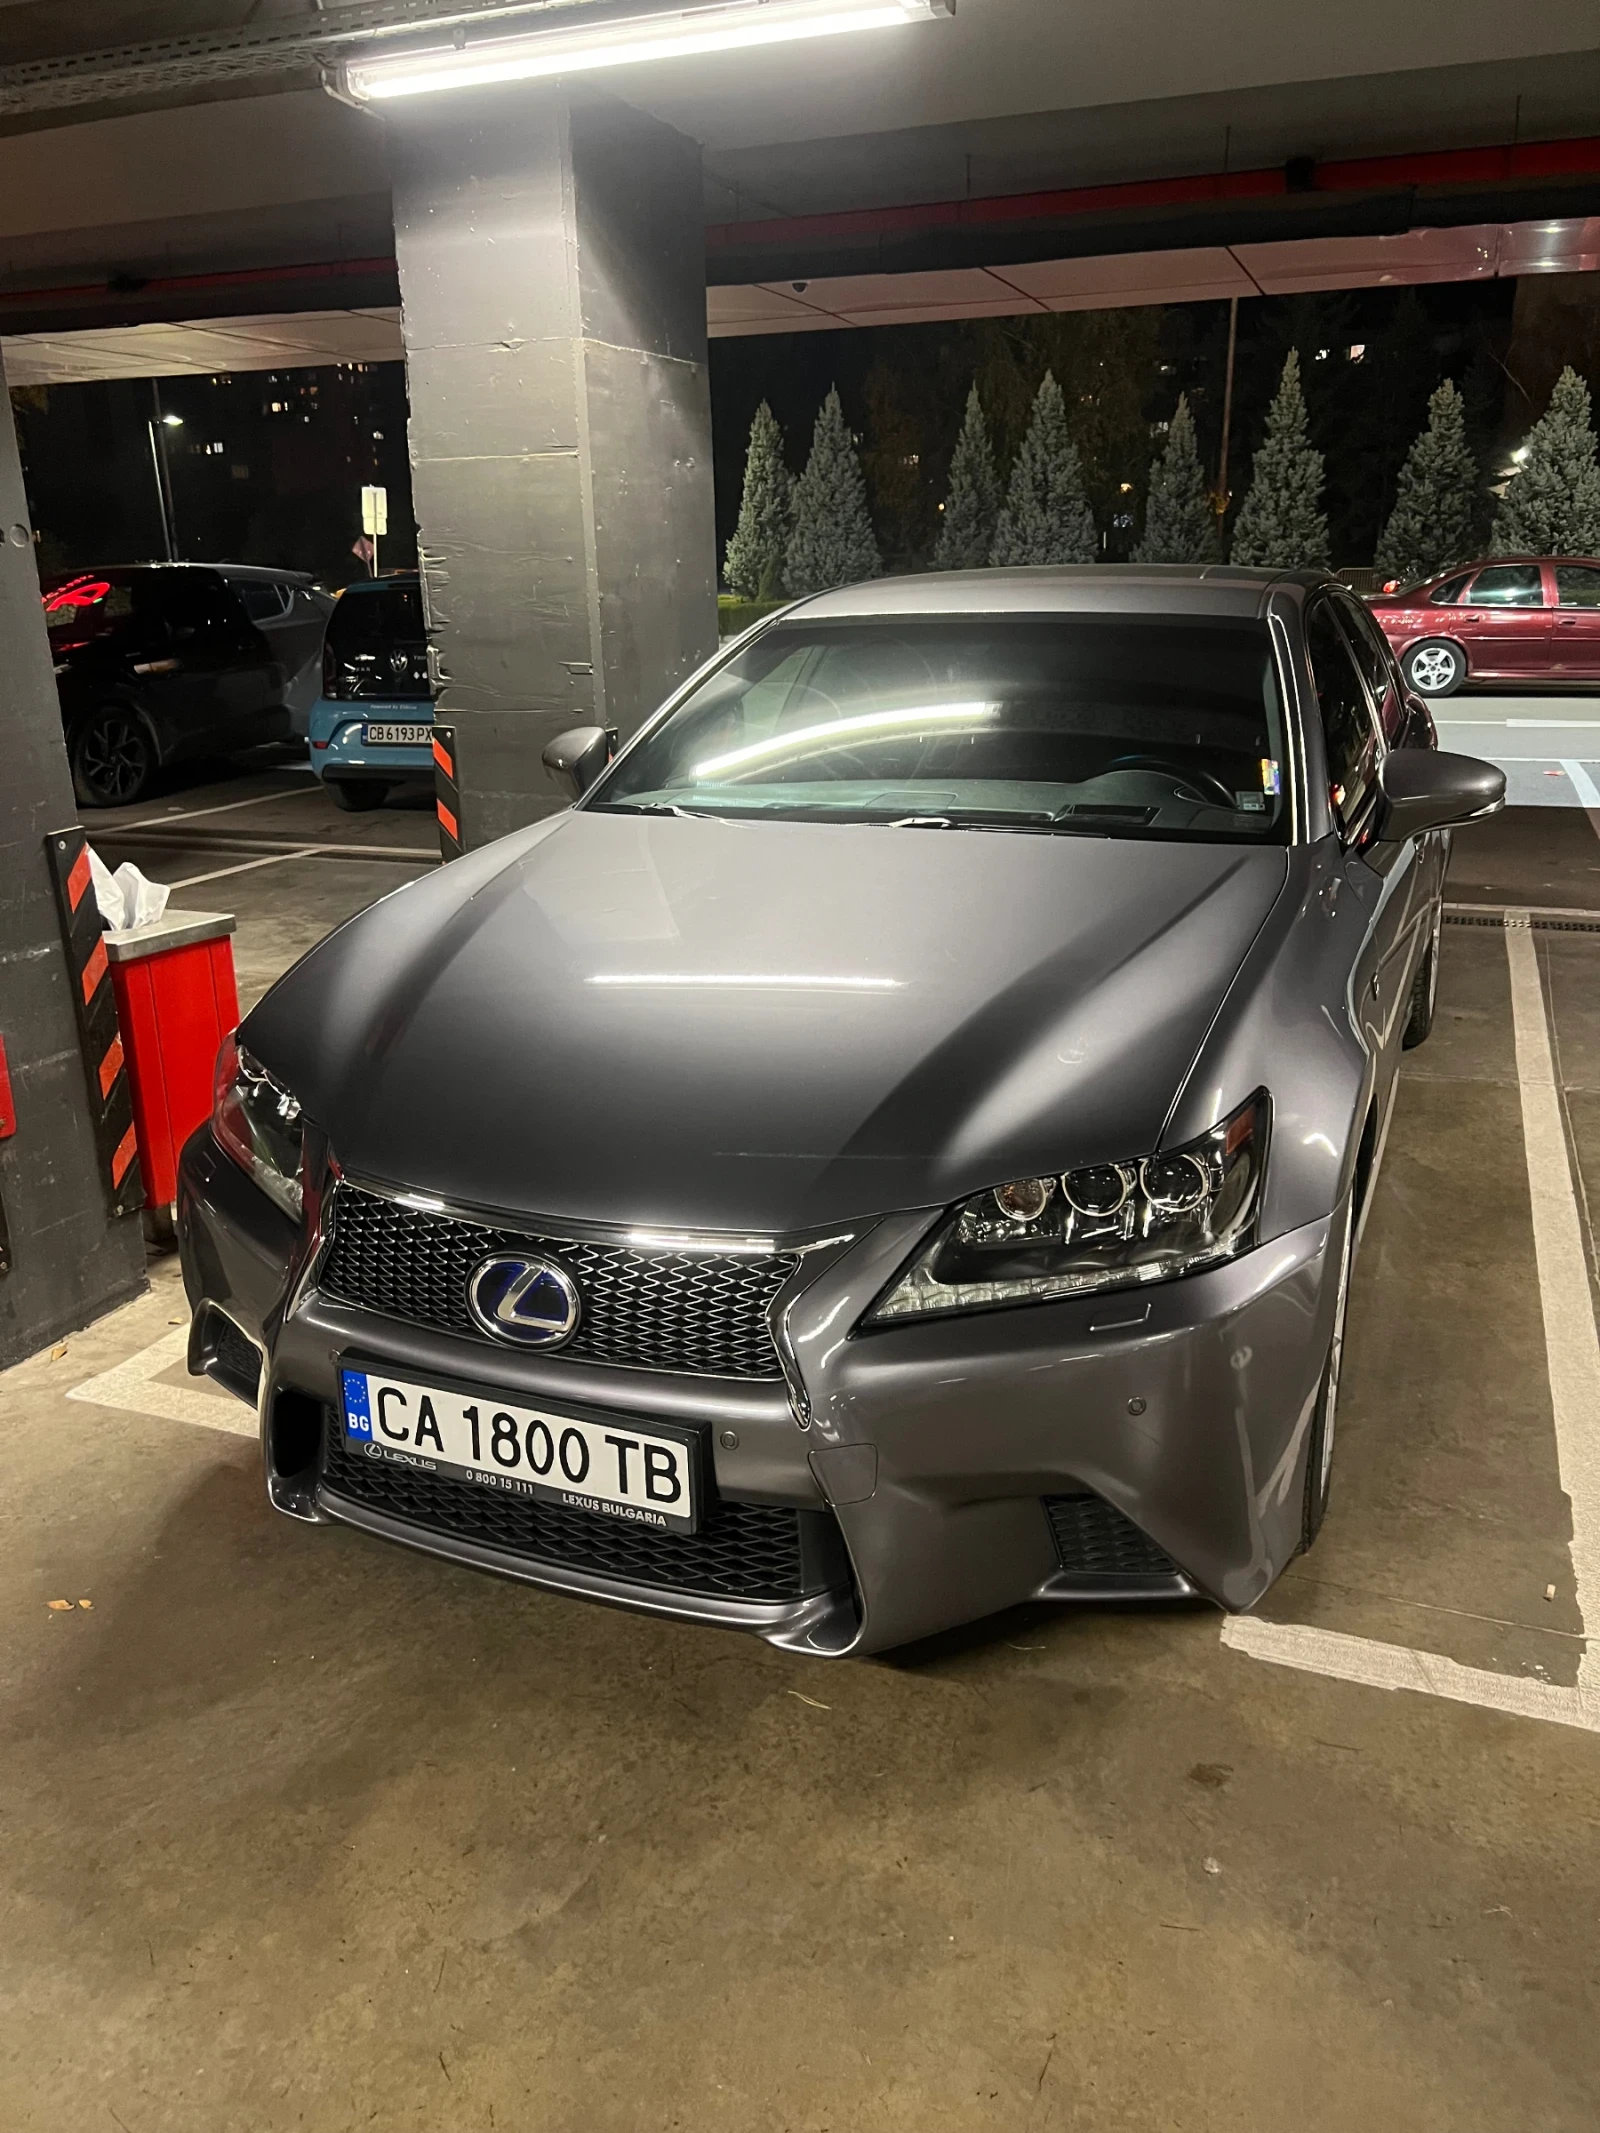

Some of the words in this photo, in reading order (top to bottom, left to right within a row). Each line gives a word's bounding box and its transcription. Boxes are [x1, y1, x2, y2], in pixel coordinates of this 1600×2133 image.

[369, 726, 384, 741] CB
[386, 727, 415, 741] 6193
[416, 727, 432, 741] PX
[348, 1412, 370, 1432] BG
[377, 1387, 444, 1453] CA
[463, 1405, 590, 1484] 1800
[605, 1435, 682, 1503] TB
[384, 1450, 437, 1471] LEXUS
[466, 1470, 473, 1480] 0
[475, 1472, 496, 1486] 800
[500, 1478, 512, 1489] 15
[516, 1481, 533, 1495] 111
[562, 1493, 600, 1511] LEXUS
[602, 1502, 667, 1527] BULGARIA
